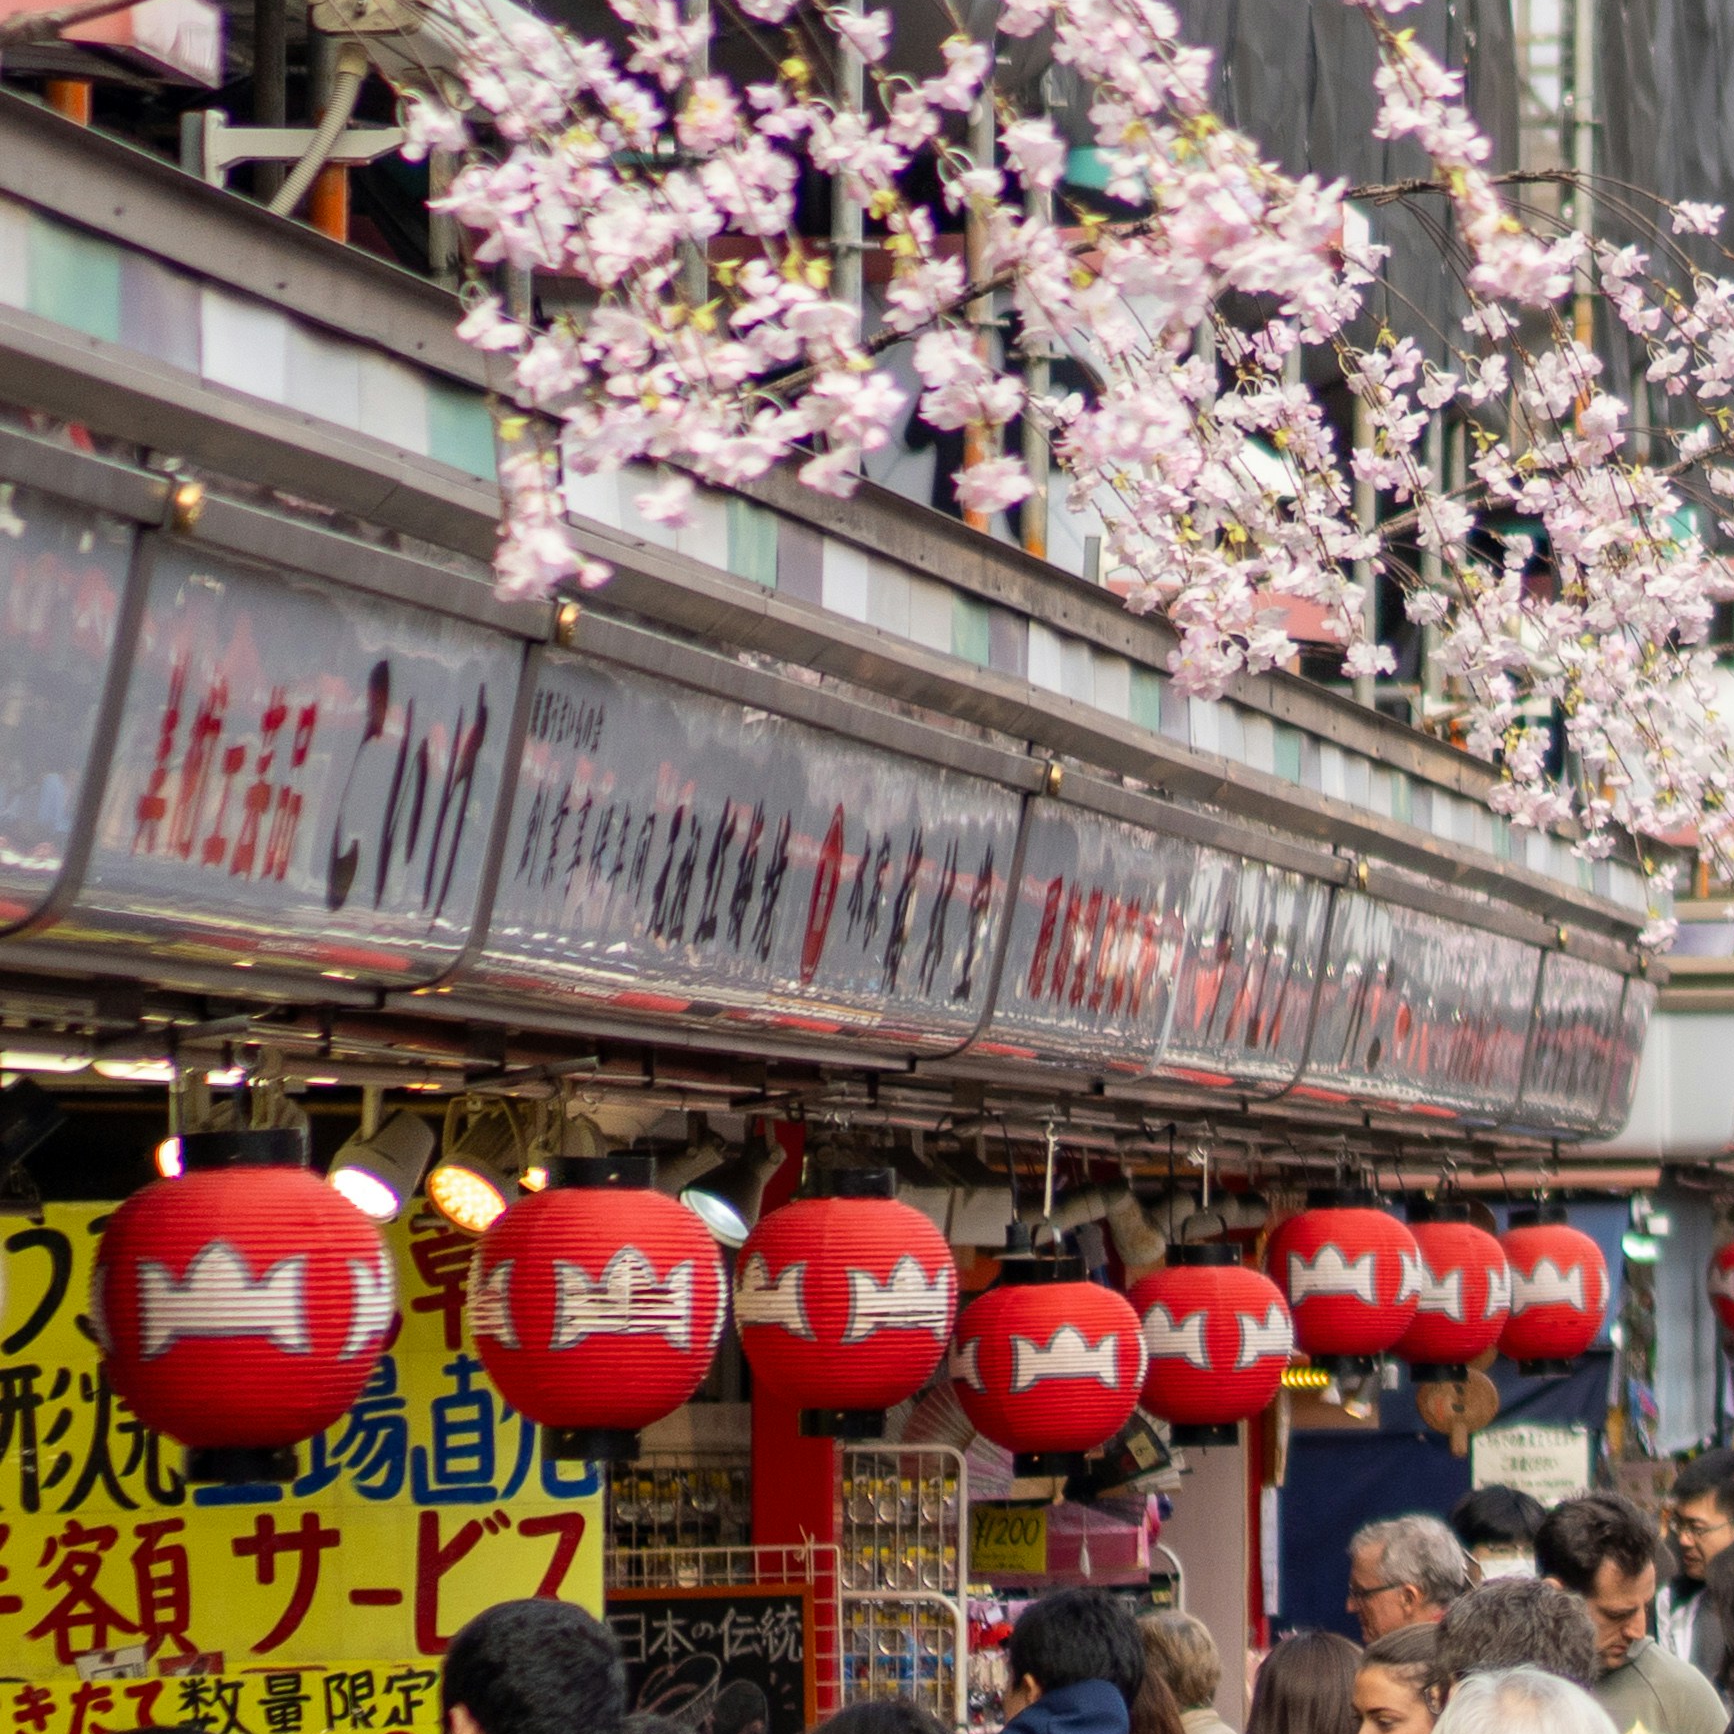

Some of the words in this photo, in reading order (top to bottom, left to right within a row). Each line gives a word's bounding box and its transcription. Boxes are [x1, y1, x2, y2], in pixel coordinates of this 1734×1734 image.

[604, 1603, 803, 1664] 日本の伝統
